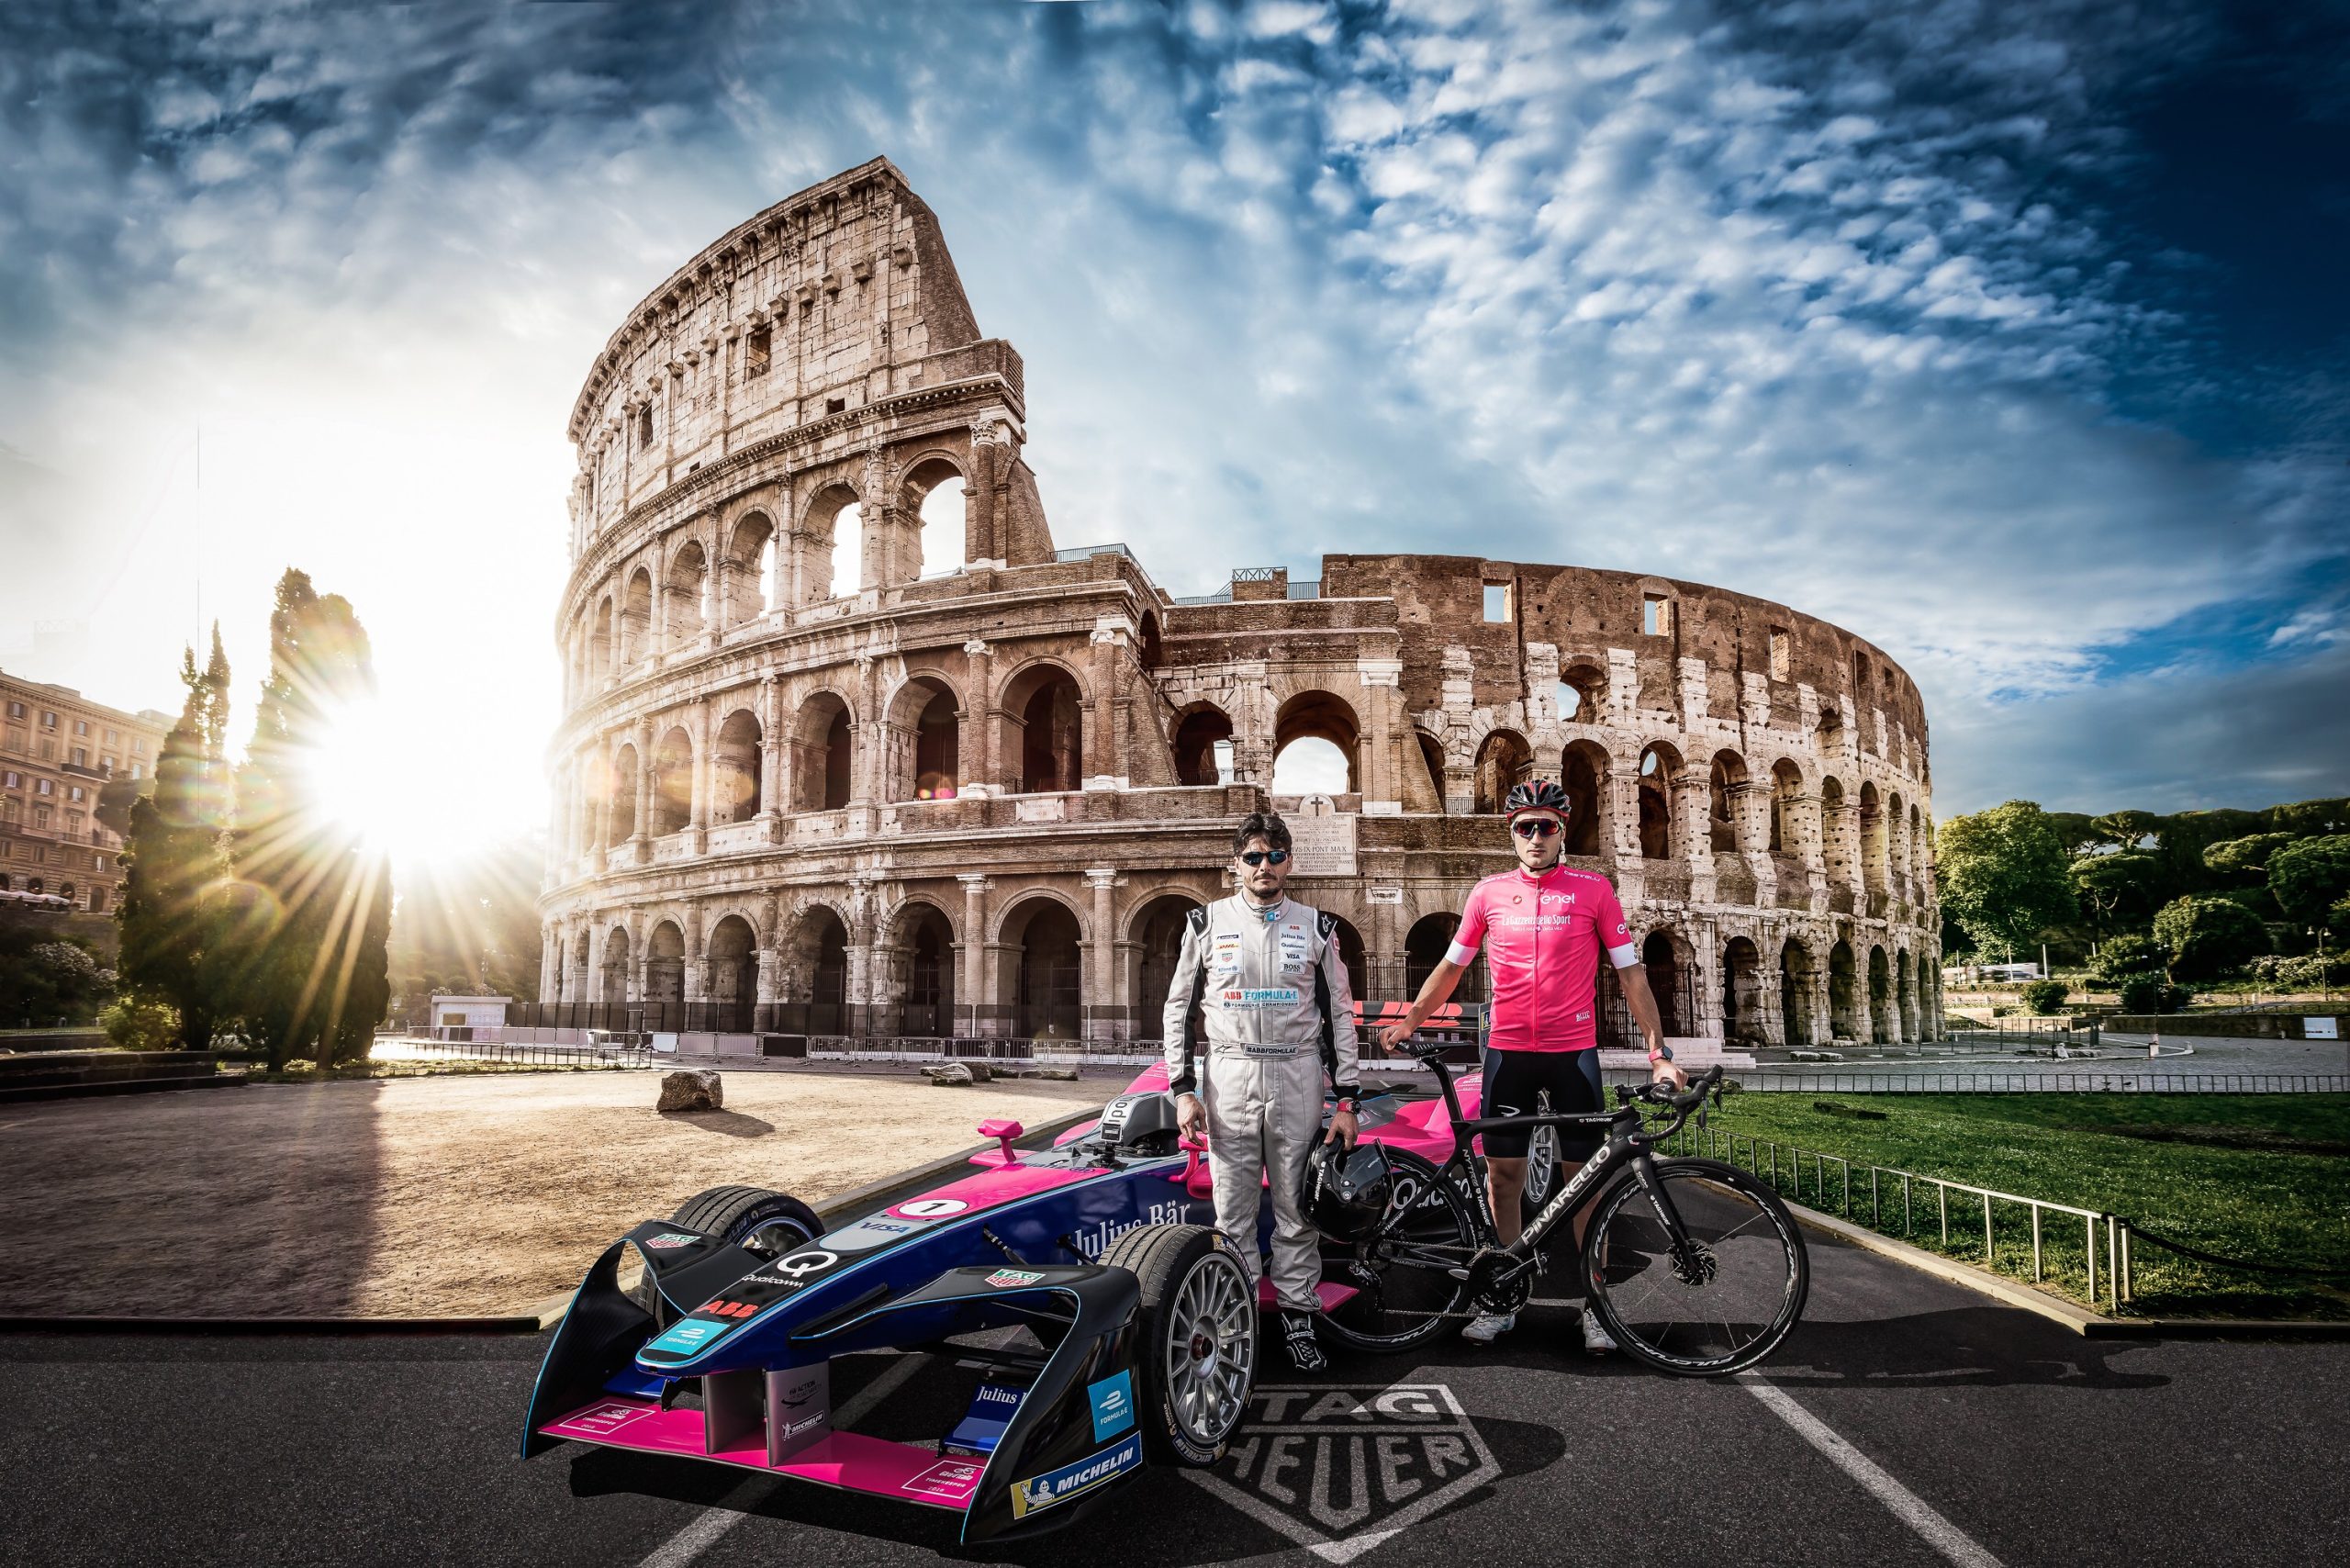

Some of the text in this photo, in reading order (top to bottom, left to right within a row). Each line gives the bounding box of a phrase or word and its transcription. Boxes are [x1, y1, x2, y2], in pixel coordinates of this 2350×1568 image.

[1539, 893, 1575, 905] enel
[1536, 914, 1552, 925] dello
[1552, 913, 1572, 925] Sport
[1224, 991, 1241, 1000] ABB
[1520, 1146, 1611, 1246] PINARELLO
[919, 1203, 948, 1214] 1
[1148, 1200, 1191, 1226] Bär
[860, 1221, 912, 1234] VISA
[663, 1234, 695, 1242] TAG
[741, 1273, 805, 1289] Qualcomm
[1002, 1271, 1038, 1280] TAG
[694, 1299, 759, 1318] ABB
[976, 1385, 1018, 1405] Julius
[1250, 1391, 1441, 1422] TAG
[791, 1413, 823, 1433] MICHELIN
[1175, 1438, 1213, 1462] MICHELIN
[1056, 1446, 1135, 1494] MICHELIN
[925, 1477, 967, 1488] TIMEKEEPER
